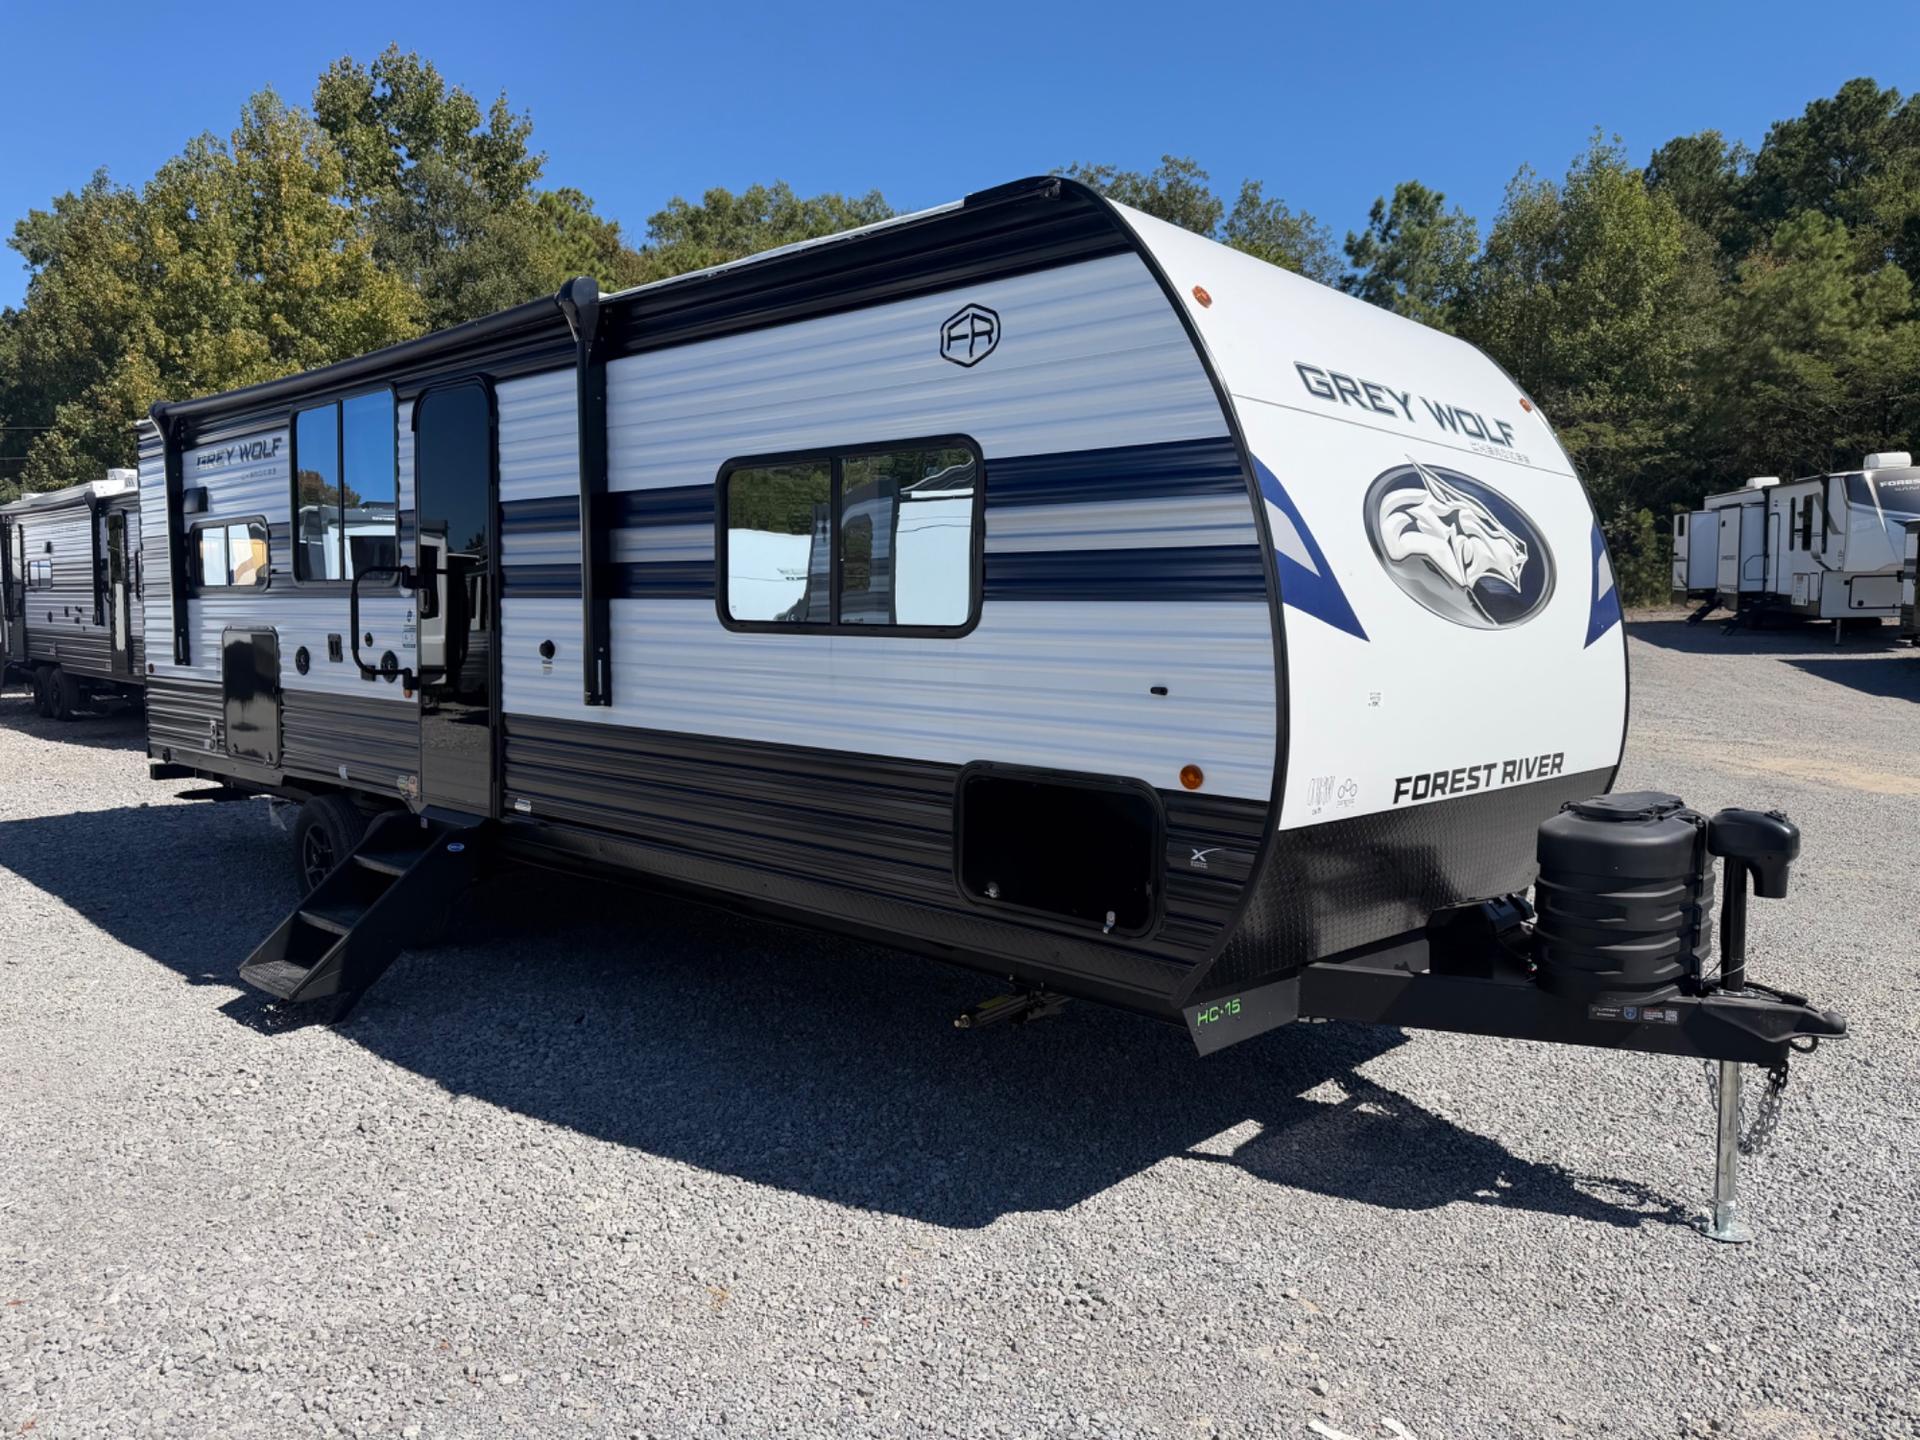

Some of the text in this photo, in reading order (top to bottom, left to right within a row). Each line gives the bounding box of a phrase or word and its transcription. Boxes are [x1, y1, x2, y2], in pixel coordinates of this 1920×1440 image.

[1293, 361, 1515, 449] GREY WOLF
[239, 437, 283, 462] WOLF
[1393, 752, 1565, 805] FOREST RIVER
